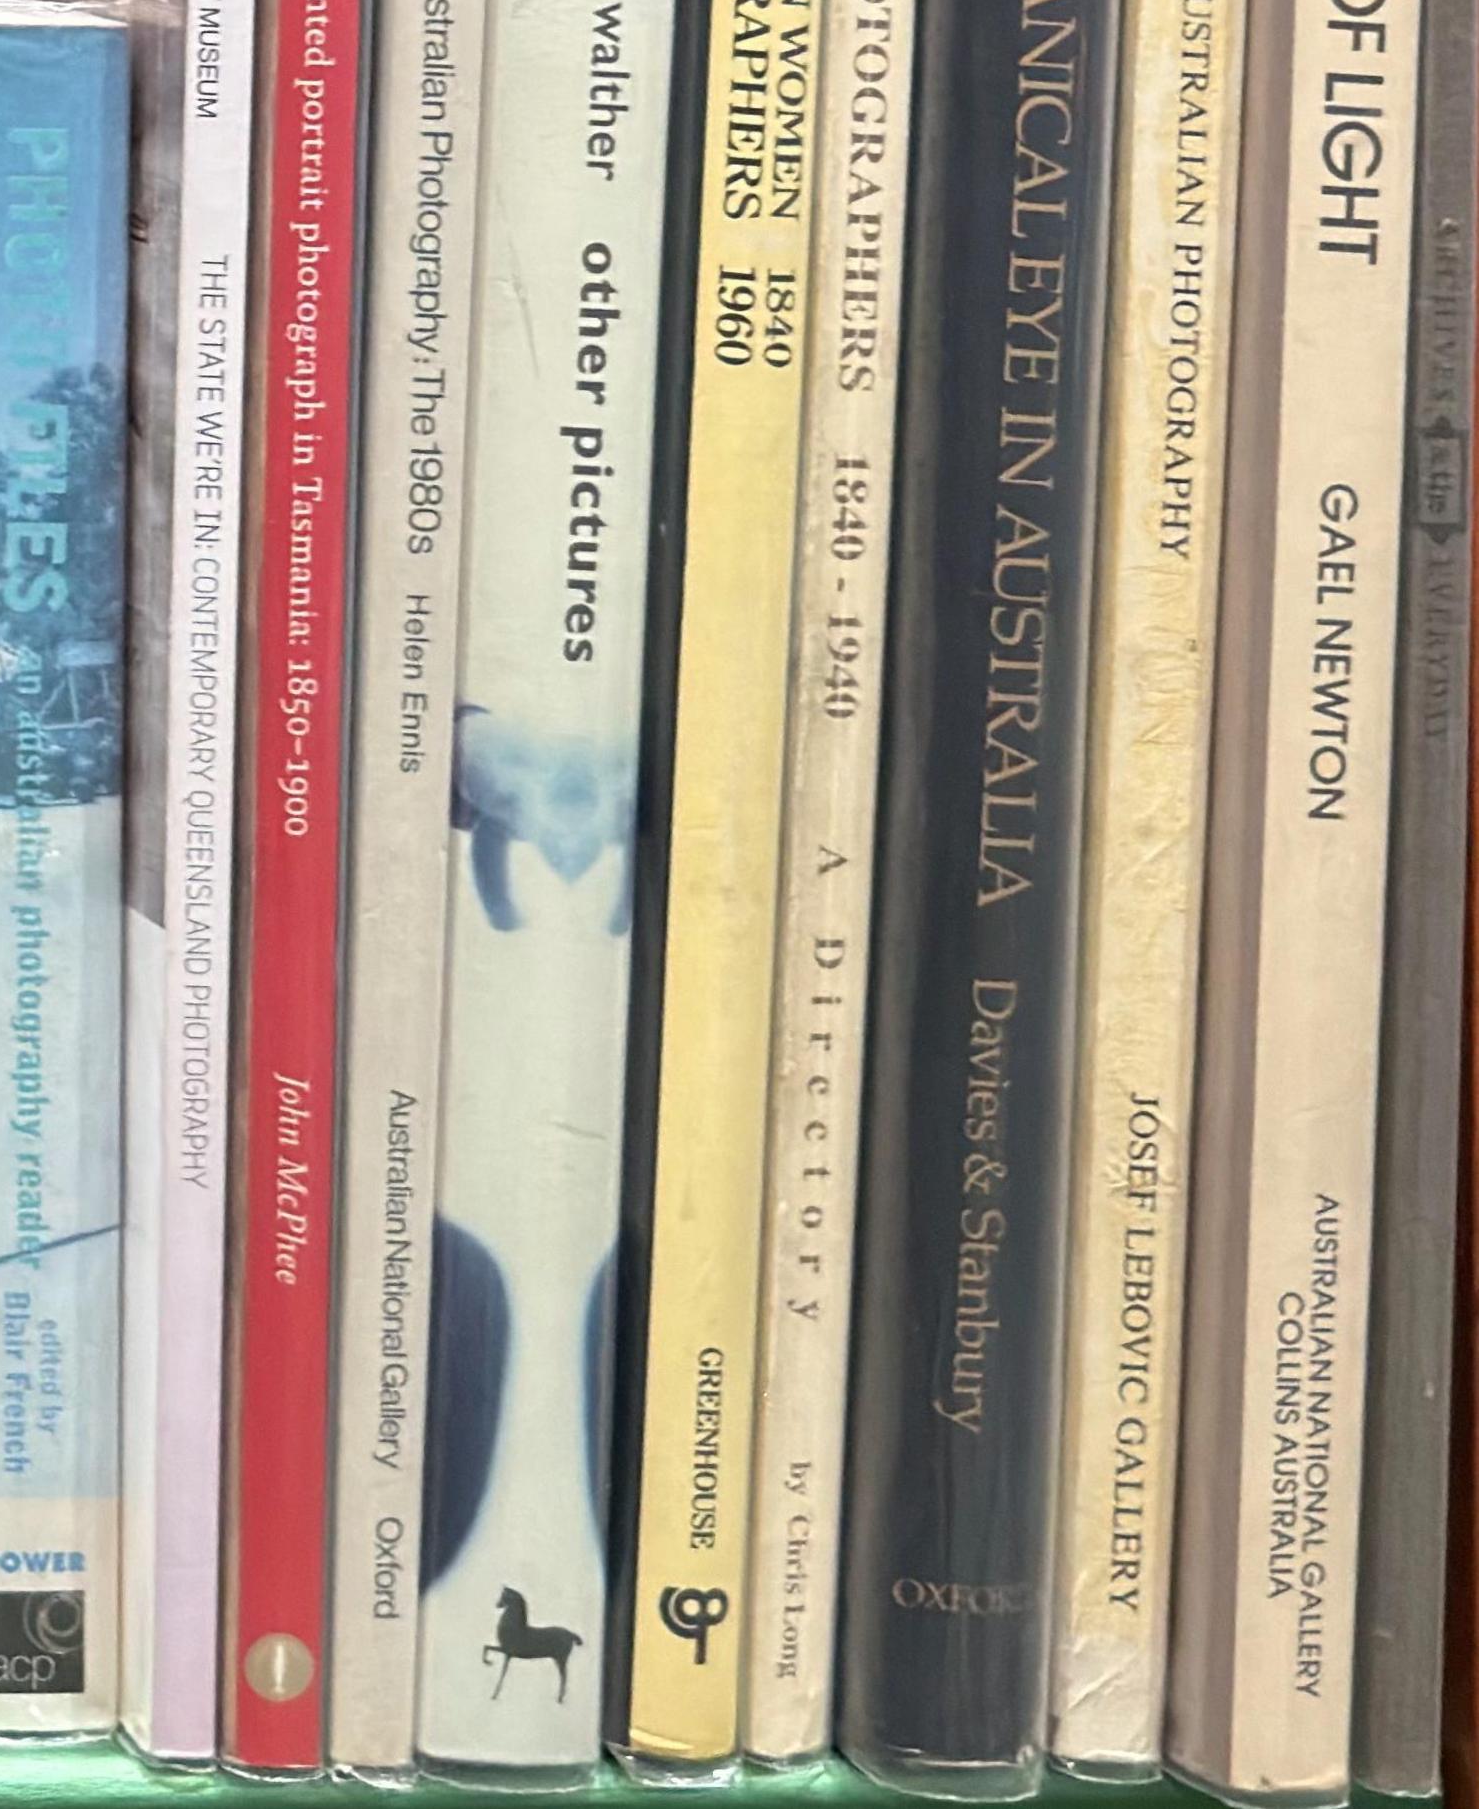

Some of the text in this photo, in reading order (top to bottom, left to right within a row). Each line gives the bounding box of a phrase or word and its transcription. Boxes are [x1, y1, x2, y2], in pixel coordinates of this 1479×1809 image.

[194, 1, 220, 118] MUSEUM
[296, 78, 333, 212] portrait
[582, 6, 635, 181] walther
[769, 28, 811, 221] WOMEN
[407, 131, 454, 362] Photography:
[1319, 72, 1384, 265] LIGHT
[288, 219, 329, 423] photograph
[411, 370, 446, 436] The
[716, 266, 754, 365] 1960
[762, 270, 794, 368] 1840
[1002, 257, 1065, 384] EYE
[1159, 245, 1205, 560] PHOTOGRAPHY
[296, 432, 323, 465] in
[410, 444, 444, 553] 1980s
[560, 241, 621, 663] other pictures
[829, 455, 873, 561] 1840
[998, 407, 1057, 489] IN
[290, 477, 323, 647] Tasmania:
[1307, 484, 1359, 820] GAEL NEWTON
[182, 256, 228, 1188] THE STATE WE'RE IN: CONTEMPORARY QUEENSLAND PHOTOGRAPHY
[399, 595, 431, 774] Helen Ennis
[825, 614, 861, 720] 1940
[978, 504, 1050, 907] AUSTRALIA
[273, 1074, 311, 1286] John McPhee
[373, 1089, 417, 1471] Australian National Gallery
[1110, 1092, 1159, 1610] JOSEF LEBOVIC GALLERY
[690, 1348, 725, 1549] GREENHOUSE
[1268, 1291, 1305, 1598] COLLINS AUSTRALIA
[1296, 1194, 1339, 1697] AUSTRALIAN NATIONAL GALLERY
[372, 1517, 403, 1620] Oxford
